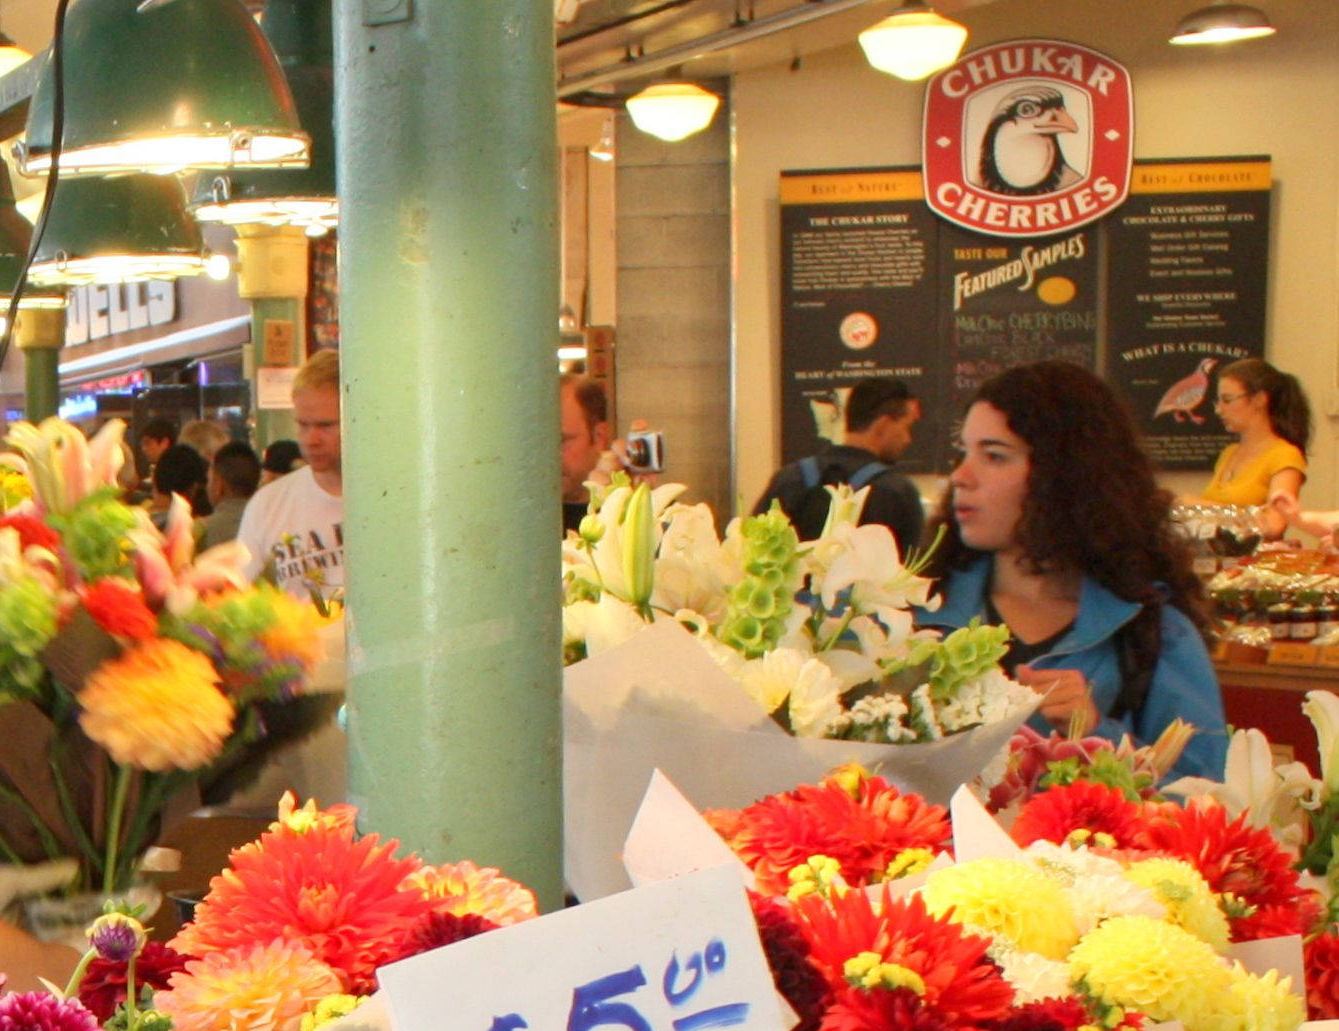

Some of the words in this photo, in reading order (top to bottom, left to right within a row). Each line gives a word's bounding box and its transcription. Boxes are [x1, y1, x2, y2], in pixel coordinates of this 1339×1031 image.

[941, 47, 1116, 98] CHUKAR
[936, 176, 1118, 227] CHERRIES
[810, 217, 829, 226] THE
[831, 215, 874, 226] CHUKAR
[876, 213, 909, 224] STORY
[953, 248, 982, 260] TASTE
[985, 247, 1008, 259] OUR
[953, 259, 1023, 312] FEATURED
[1018, 233, 1085, 292] SAMPLES
[1122, 345, 1159, 361] WHAT
[1162, 343, 1175, 353] IS
[1179, 343, 1186, 353] A
